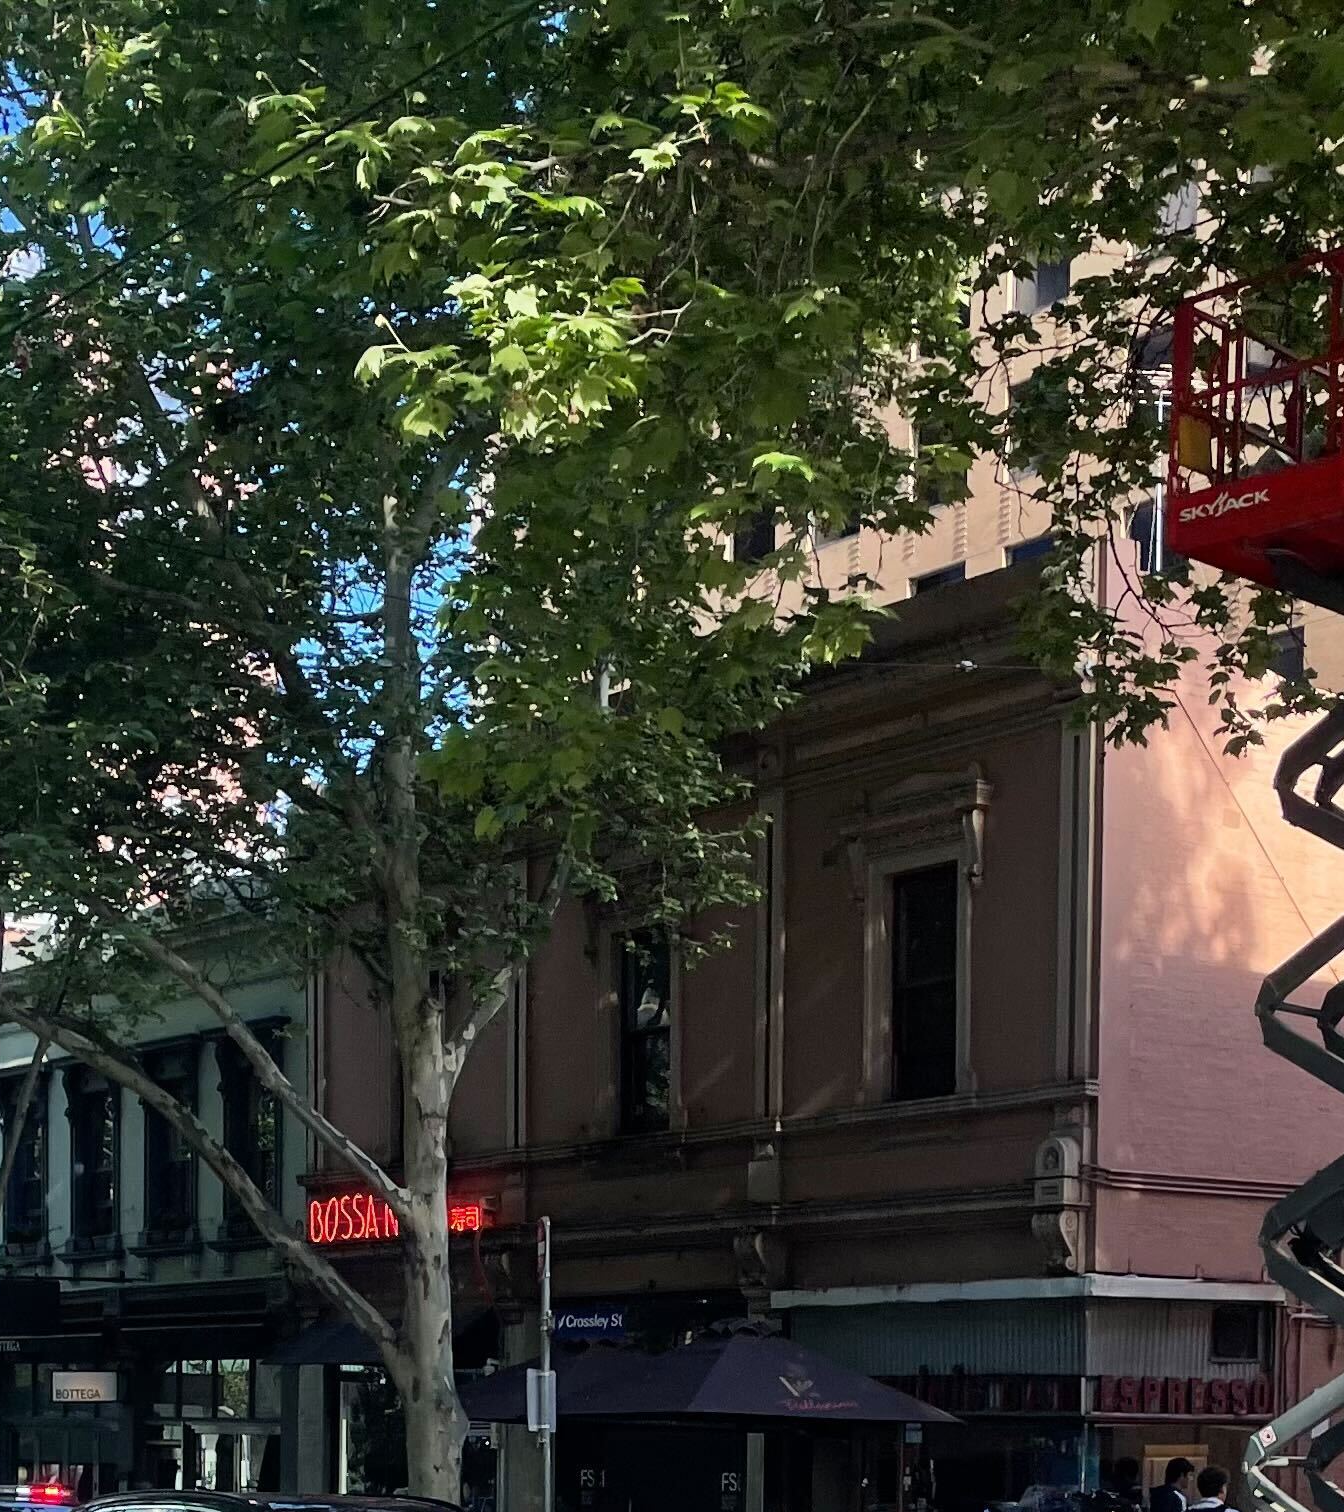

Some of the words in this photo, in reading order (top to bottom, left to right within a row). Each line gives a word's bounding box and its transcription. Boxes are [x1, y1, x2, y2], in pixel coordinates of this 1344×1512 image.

[1179, 489, 1270, 522] SKYJACK
[310, 1193, 379, 1243] BOSSA
[566, 1313, 609, 1330] Crossley
[611, 1313, 623, 1327] St
[55, 1388, 101, 1400] BOTTEGA
